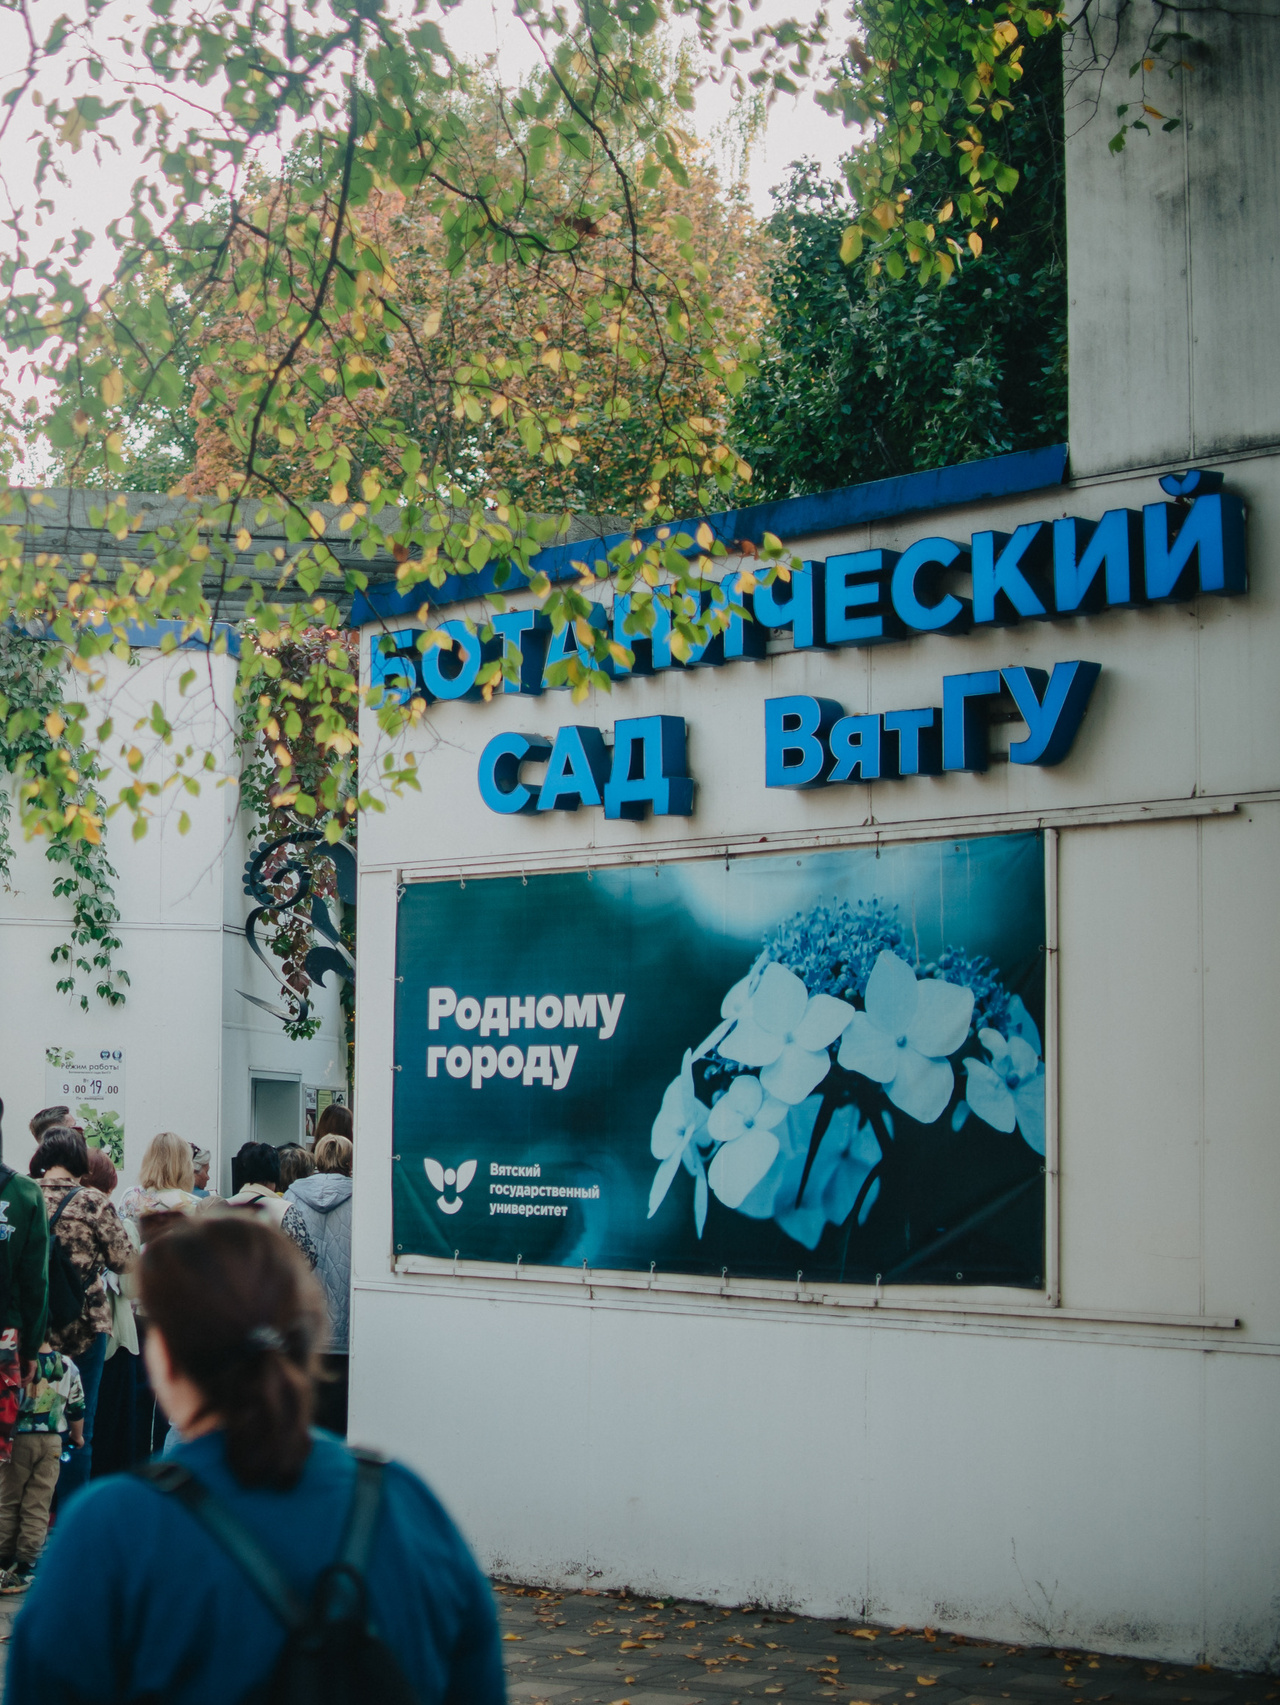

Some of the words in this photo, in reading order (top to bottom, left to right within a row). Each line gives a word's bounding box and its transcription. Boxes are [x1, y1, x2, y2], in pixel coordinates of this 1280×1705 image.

[370, 469, 1242, 711] БОТАНИЧЕСКИЙ
[478, 716, 692, 820] САД
[765, 660, 1100, 790] ВятГУ
[428, 986, 625, 1039] Родному
[89, 1063, 120, 1071] работы
[427, 1045, 579, 1090] городу
[490, 1162, 541, 1177] Вятский
[489, 1183, 600, 1199] государственный
[489, 1202, 568, 1217] университет
